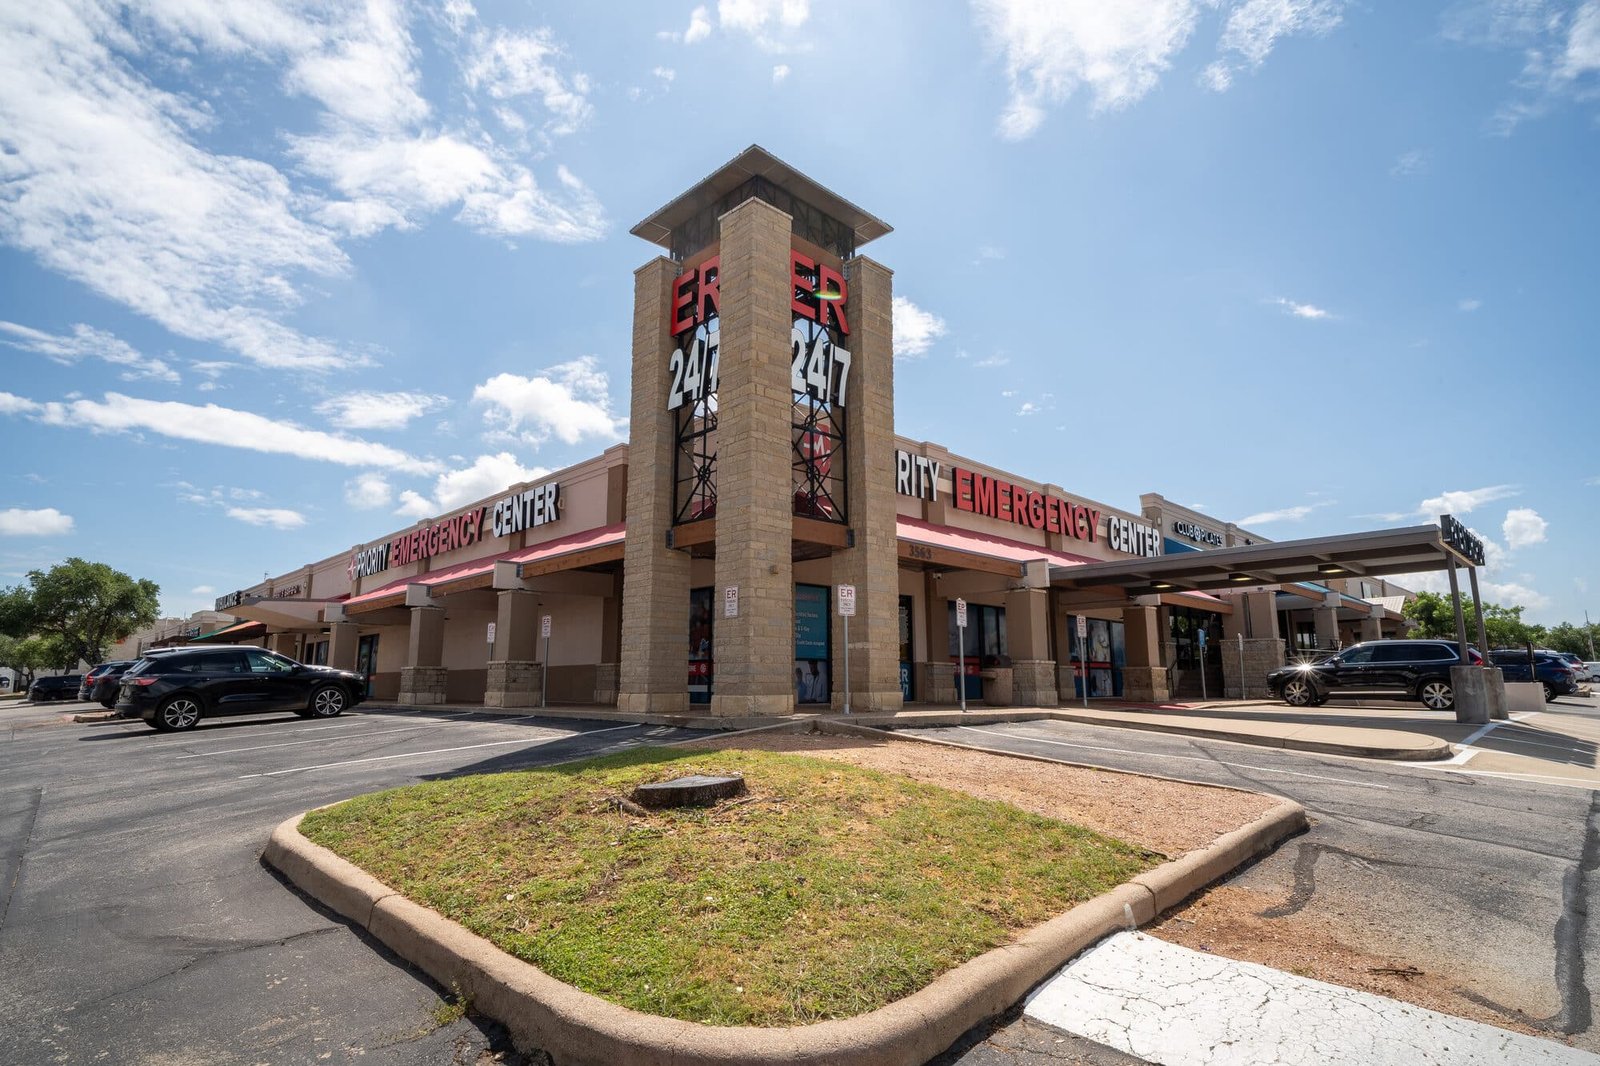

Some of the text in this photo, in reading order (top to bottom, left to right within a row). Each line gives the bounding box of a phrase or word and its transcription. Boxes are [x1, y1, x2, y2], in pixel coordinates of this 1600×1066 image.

[671, 256, 720, 337] ER
[791, 249, 849, 335] ER
[668, 329, 720, 410] 24/7
[791, 328, 851, 407] 24/7
[357, 482, 560, 579] PRIORITY EMERGENCY CENTER
[896, 450, 1161, 557] RITY EMERGENCY CENTER
[1176, 522, 1195, 538] CLUB
[727, 589, 737, 599] ER
[841, 588, 853, 598] ER
